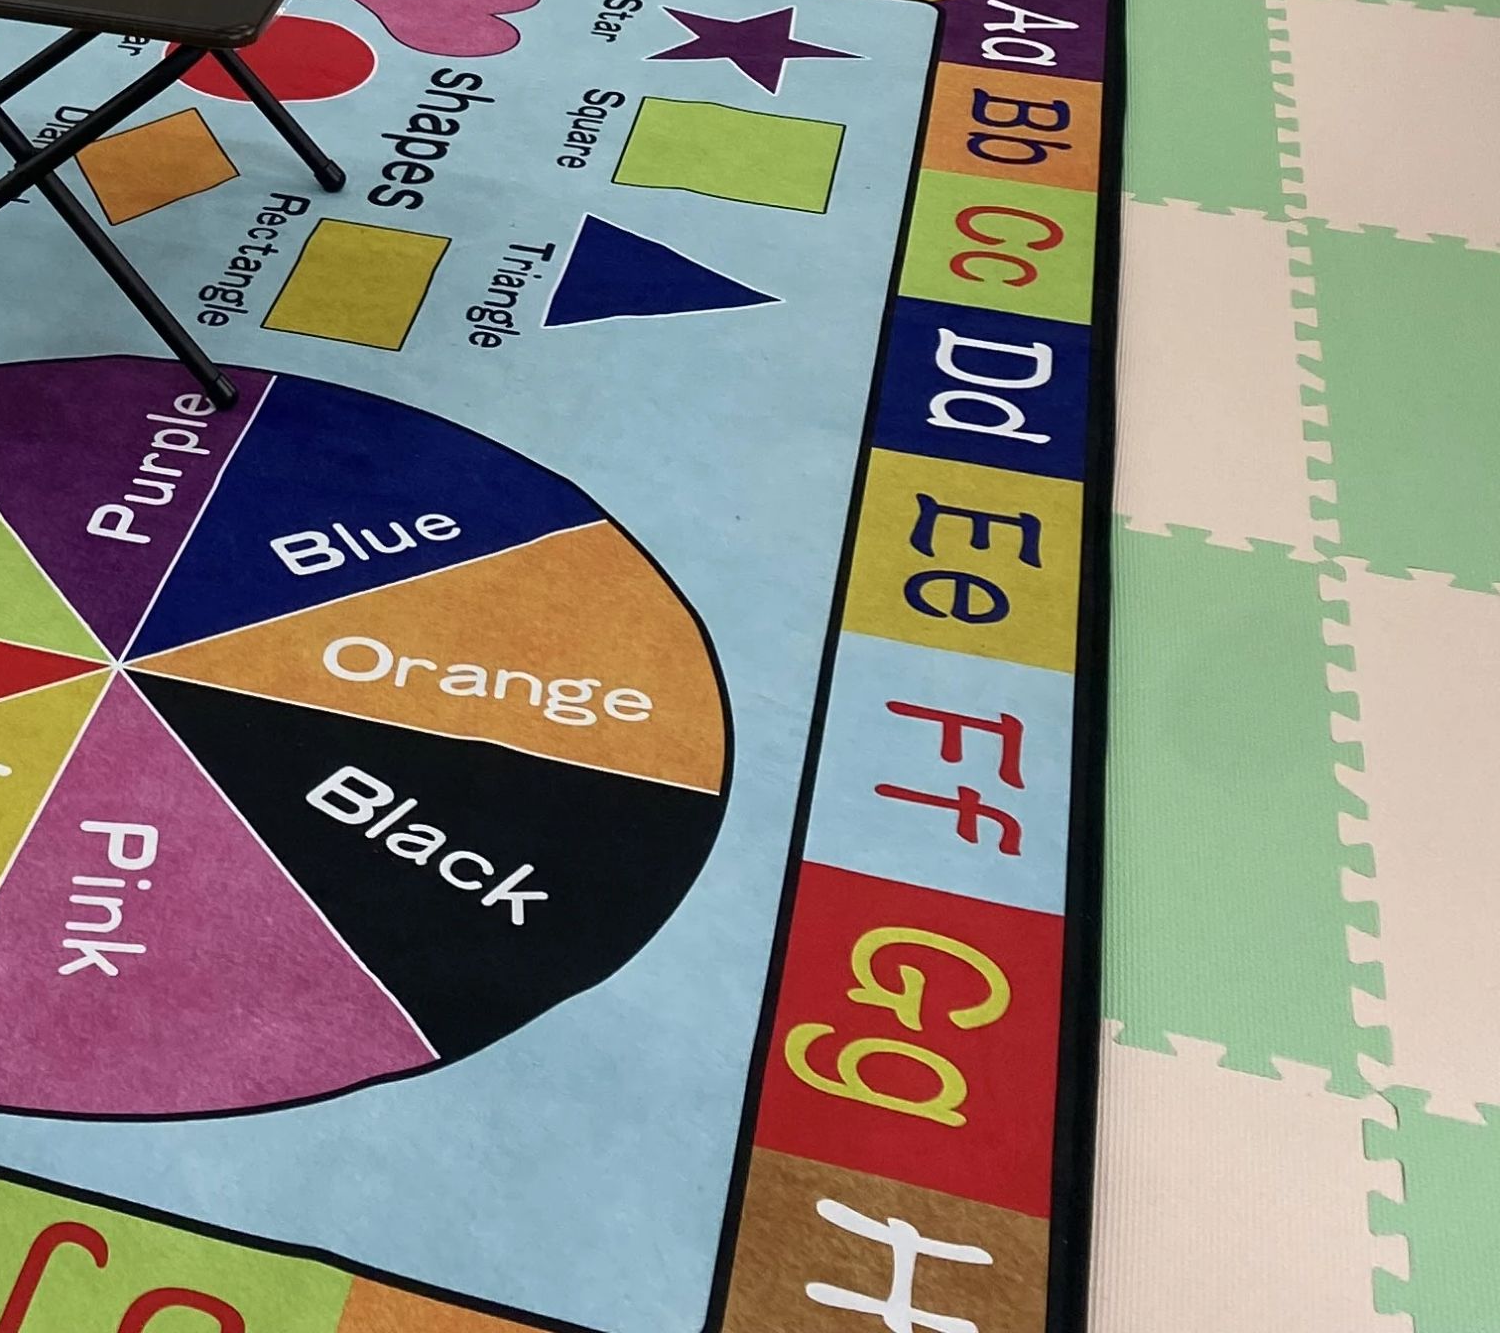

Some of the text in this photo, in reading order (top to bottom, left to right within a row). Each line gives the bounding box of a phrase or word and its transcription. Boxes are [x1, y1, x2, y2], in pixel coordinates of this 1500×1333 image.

[980, 0, 1079, 66] Aa
[556, 88, 626, 170] Square
[966, 88, 1073, 165] Bb
[196, 191, 312, 328] Rectangle
[466, 241, 557, 349] Triangle
[949, 206, 1064, 287] Cc
[926, 328, 1053, 444] Dd
[87, 391, 216, 545] Purple
[270, 507, 462, 576] Blue
[902, 493, 1042, 625] Ee
[322, 635, 655, 728] Orange
[874, 700, 1026, 856] Ff
[57, 819, 159, 978] Pink
[304, 765, 549, 926] Black
[784, 925, 1013, 1128] Gg
